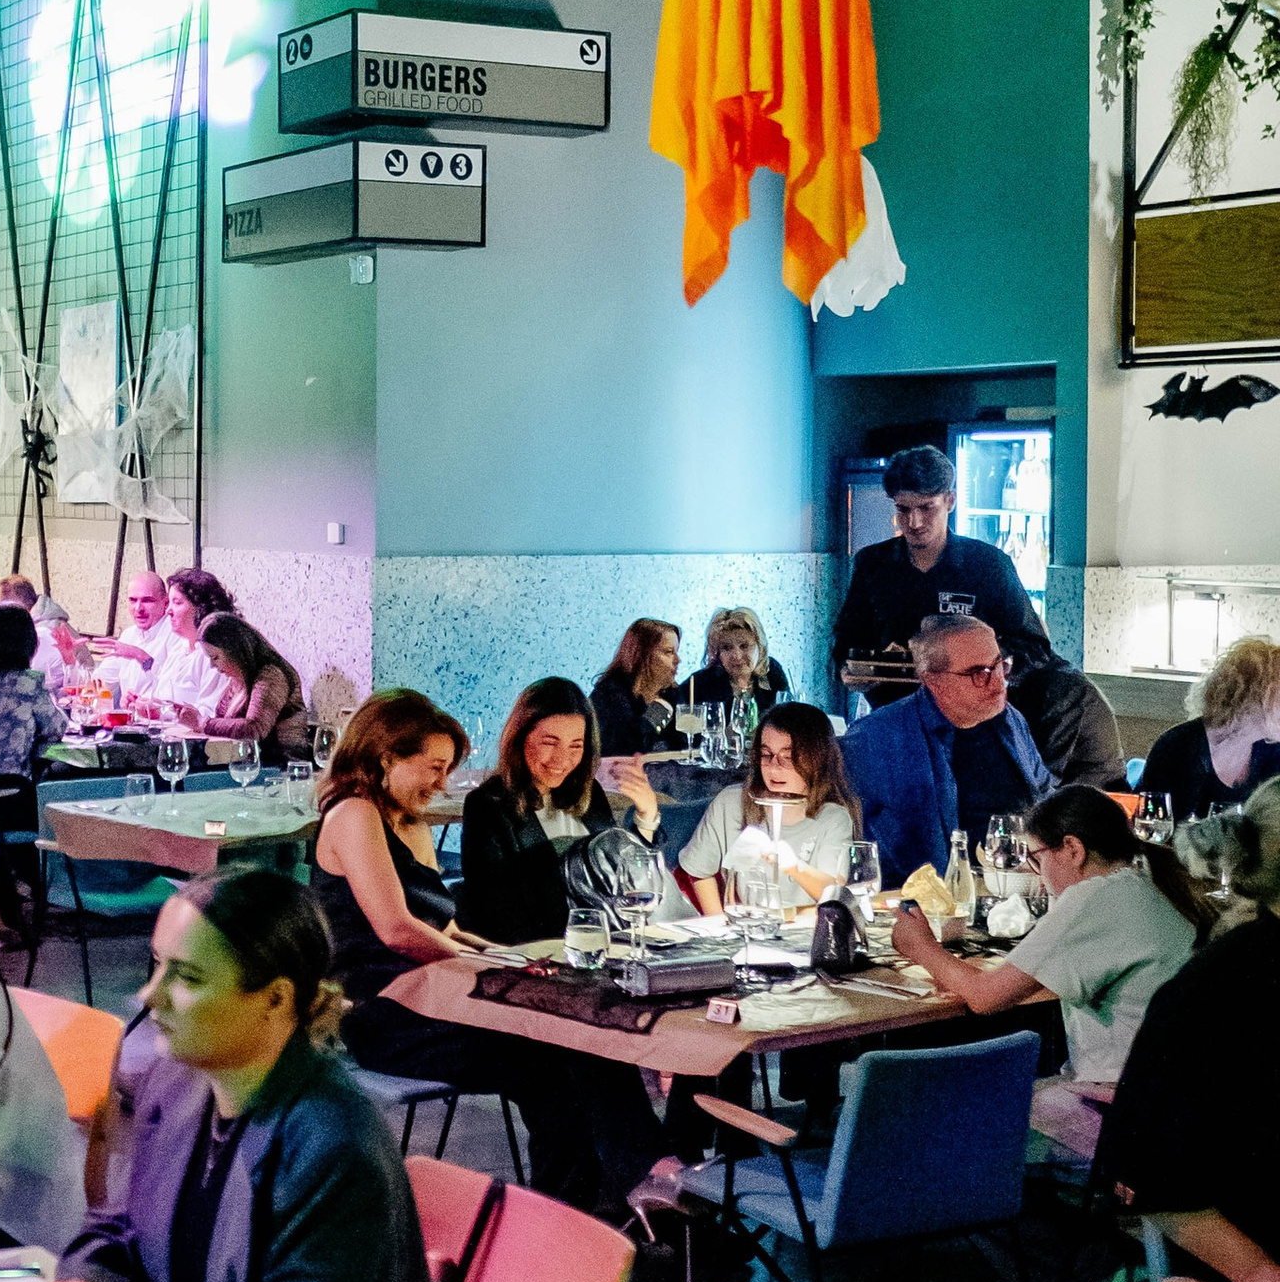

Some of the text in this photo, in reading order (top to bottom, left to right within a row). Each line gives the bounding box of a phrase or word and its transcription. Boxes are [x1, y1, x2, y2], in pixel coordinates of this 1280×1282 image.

[364, 58, 487, 97] BURGERS
[363, 89, 483, 114] GRILLED FOOD
[225, 207, 263, 239] PIZZA
[712, 1003, 730, 1016] 31
